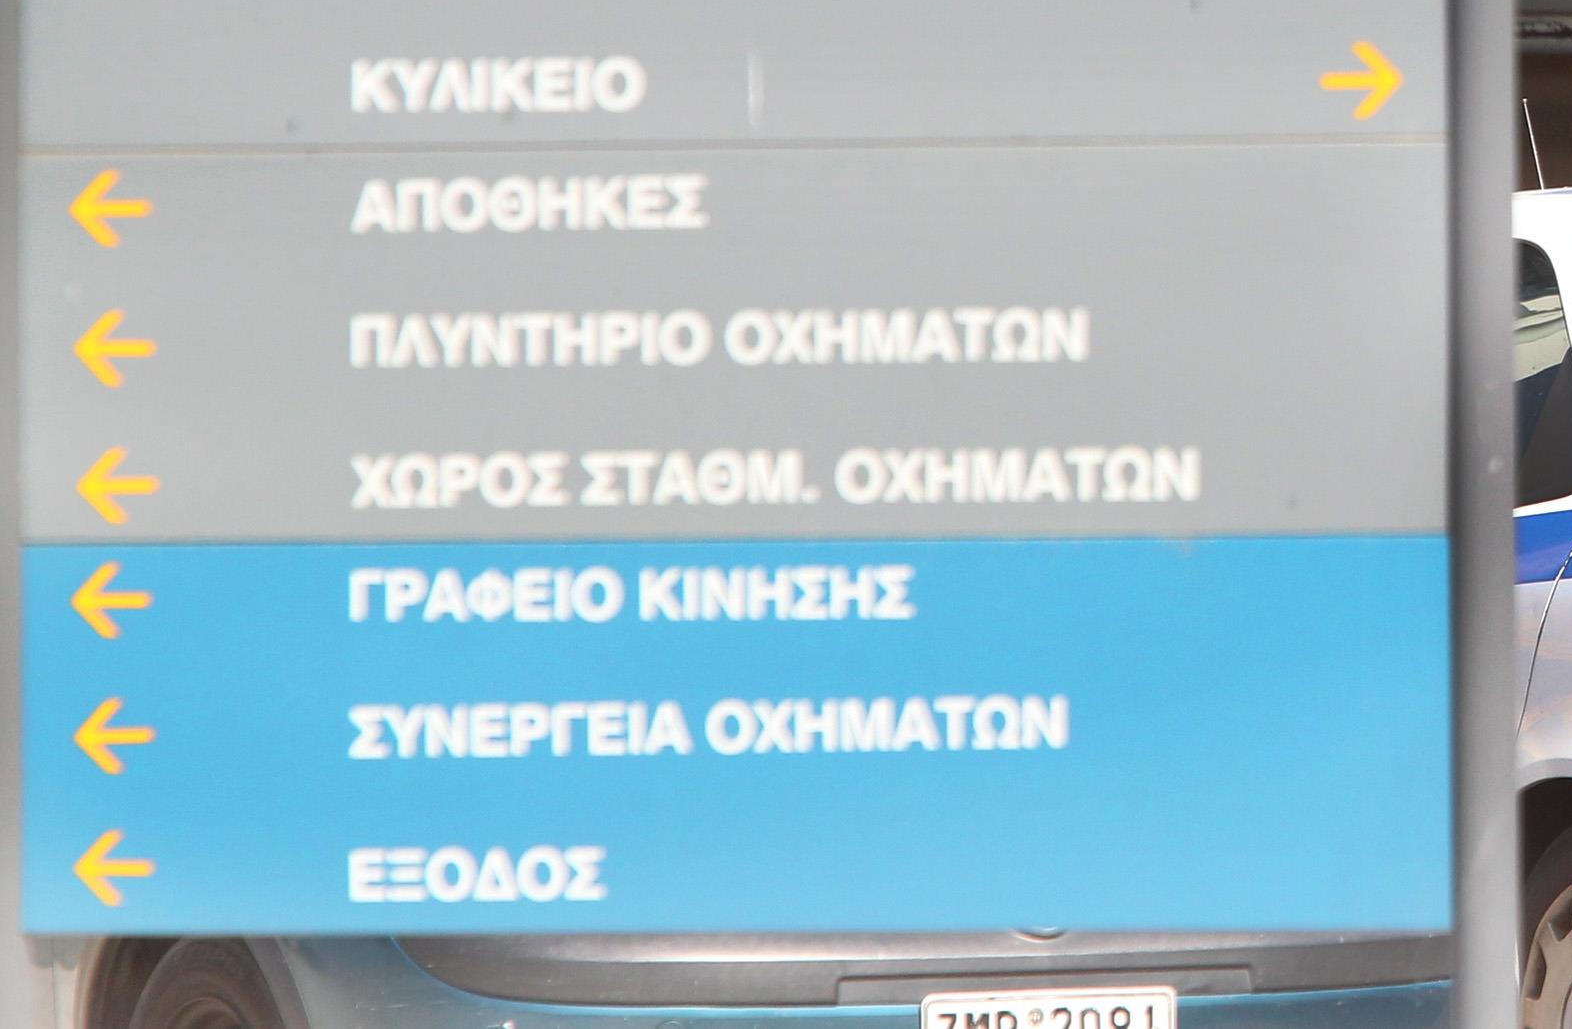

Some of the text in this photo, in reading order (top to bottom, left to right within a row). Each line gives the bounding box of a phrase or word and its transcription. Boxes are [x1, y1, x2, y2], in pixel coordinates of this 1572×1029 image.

[350, 55, 647, 114] ΚΥΛΙΚΕΙΟ
[350, 173, 709, 233] ΑΠΟΘΗΚΕΣ
[348, 306, 1089, 368] ΠΛΥΝΤΗΡΙΟ ΟΧΗΜΑΤΩΝ
[350, 446, 1200, 509] ΧΩΡΟΣ ΣΤΑΘΜ. ΟΧΗΜΑΤΩΝ
[349, 565, 915, 623] ΓΡΑΦΕΙΟ ΚΙΝΗΣΗΣ
[349, 695, 1069, 760] ΣΥΝΕΡΓΕΙΑ ΟΧΗΜΑΤΩΝ
[348, 846, 608, 903] ΕΞΟΔΟΣ
